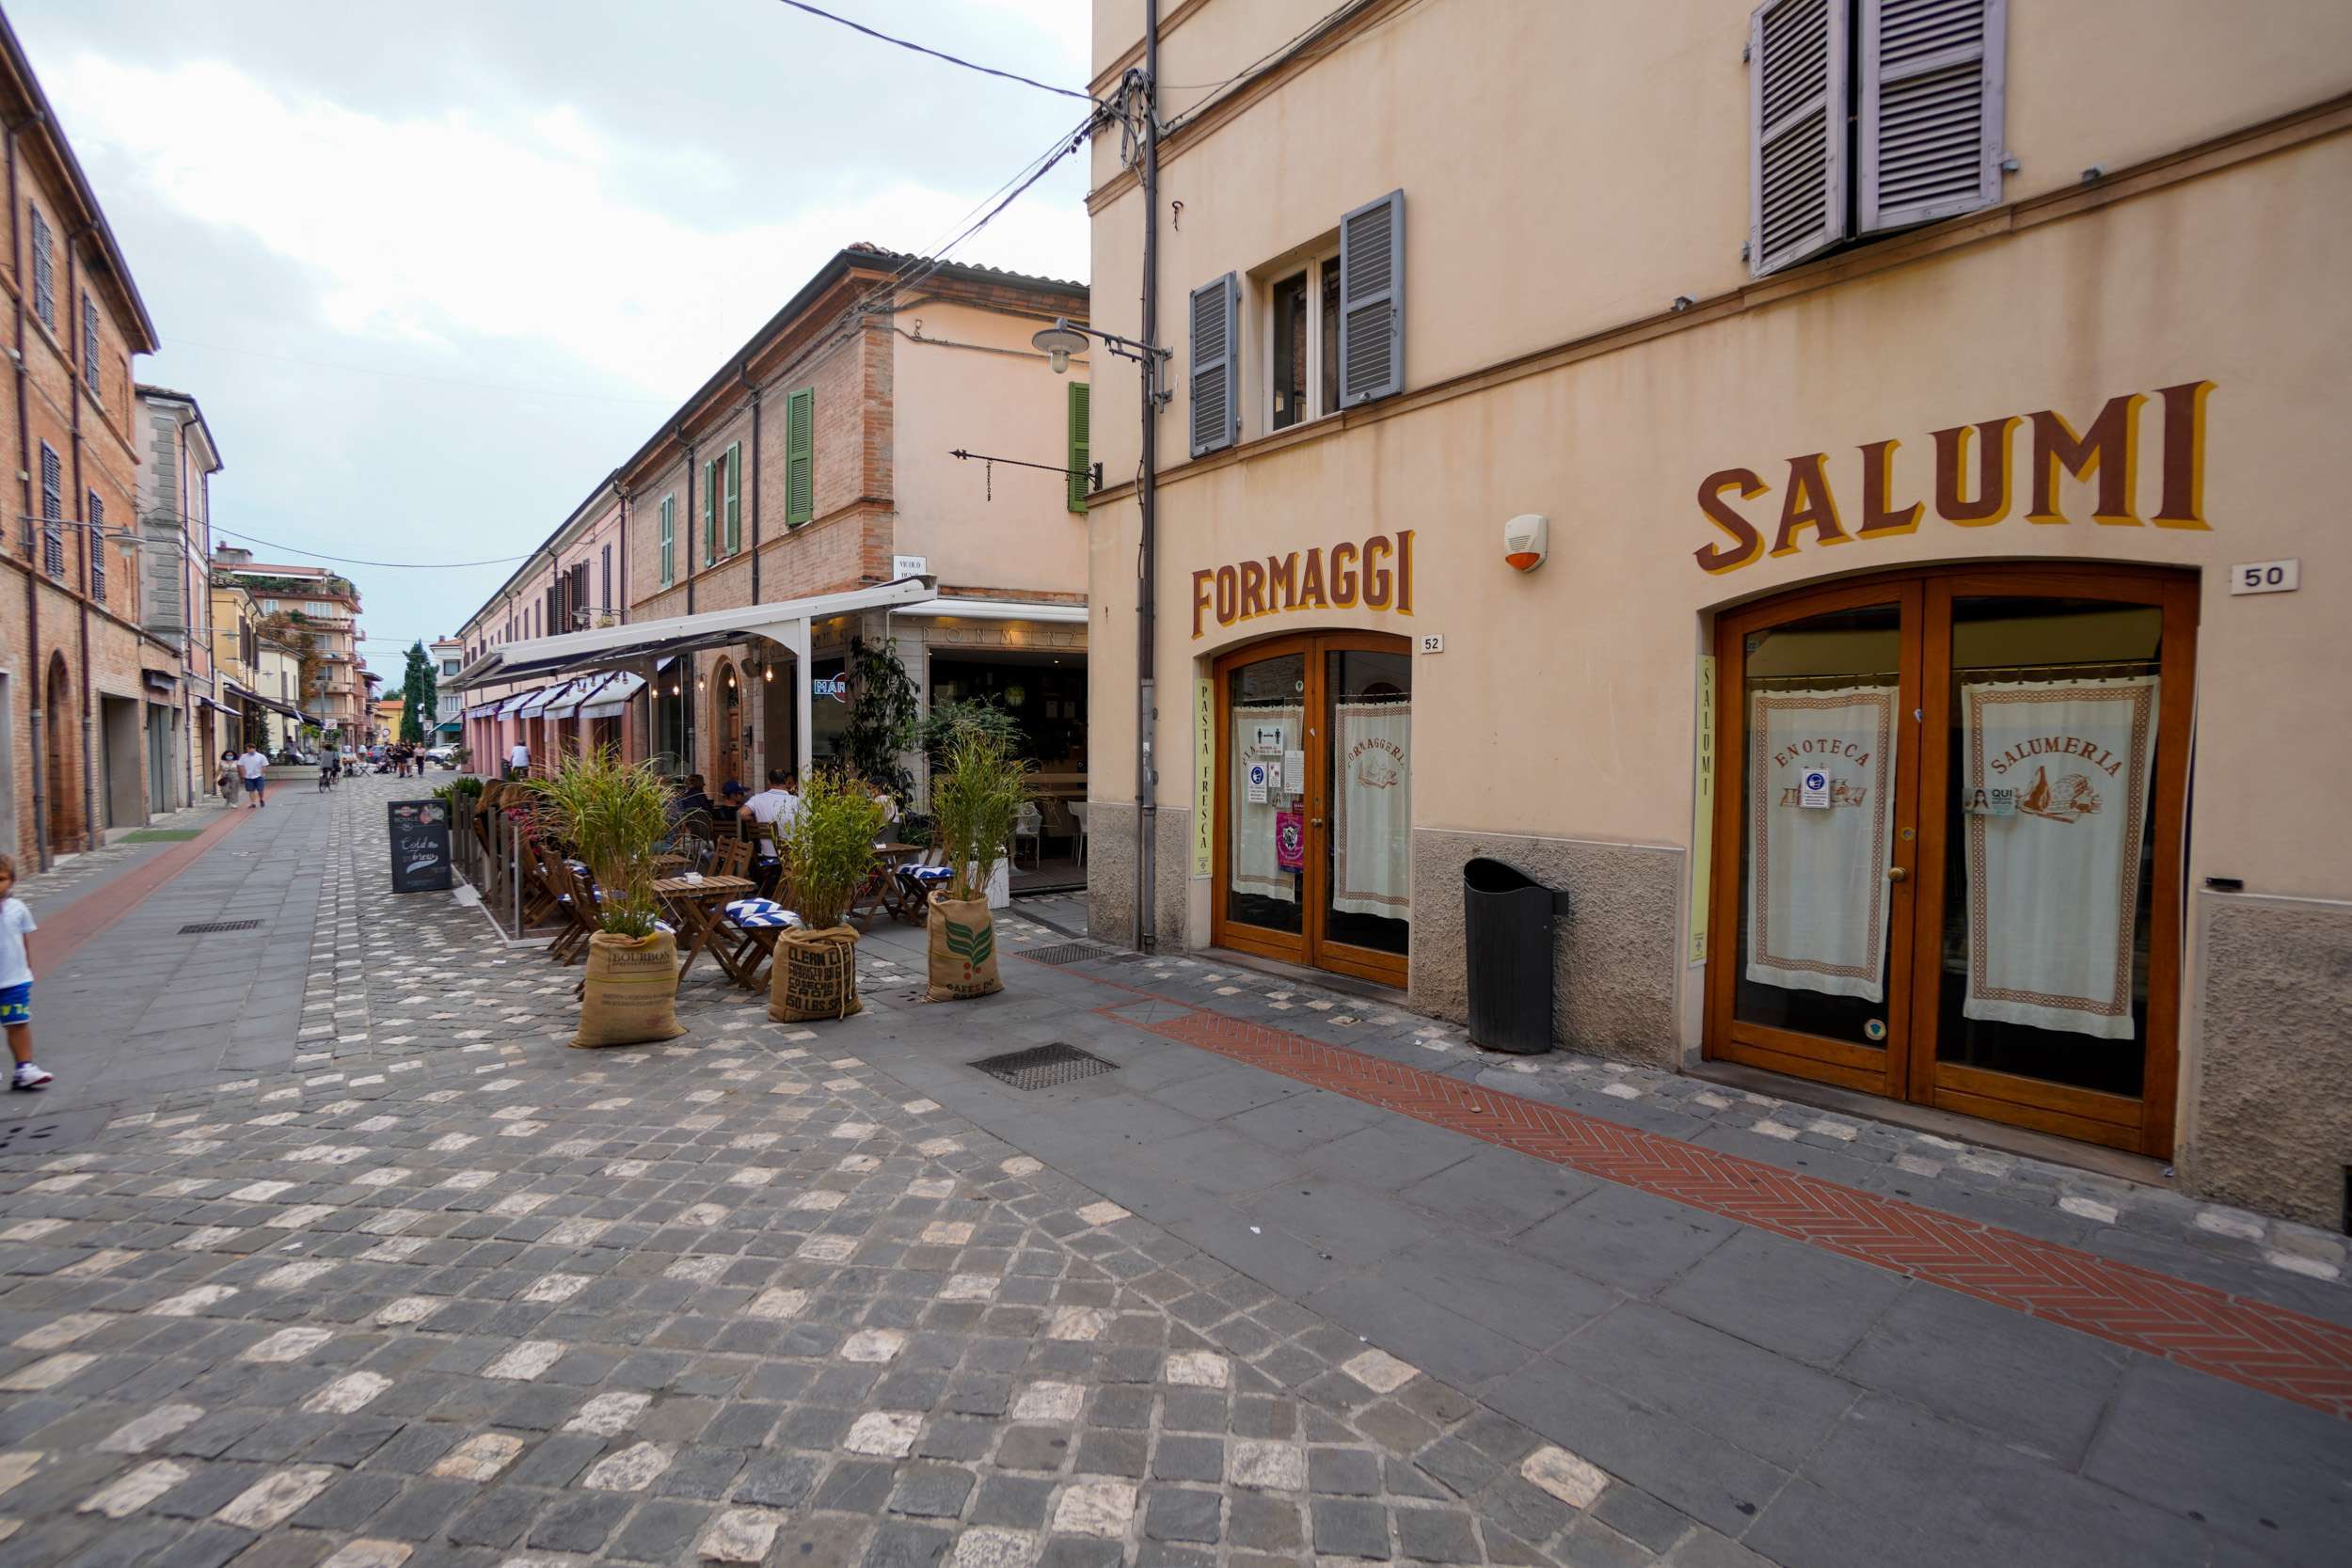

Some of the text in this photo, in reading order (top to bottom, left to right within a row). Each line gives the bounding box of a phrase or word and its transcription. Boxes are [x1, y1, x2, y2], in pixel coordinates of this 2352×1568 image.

[1692, 380, 2218, 576] SALUMI
[1191, 530, 1416, 640] FORMAGGI
[2245, 566, 2283, 587] 50
[1425, 638, 1438, 649] 52
[1200, 685, 1209, 755] PASTA
[1701, 667, 1711, 797] SALUMI
[1773, 738, 1870, 768] ENOTECA
[1990, 736, 2123, 778] SALUMERIA
[1200, 766, 1210, 849] FRESCA
[1991, 788, 2012, 799] QUI
